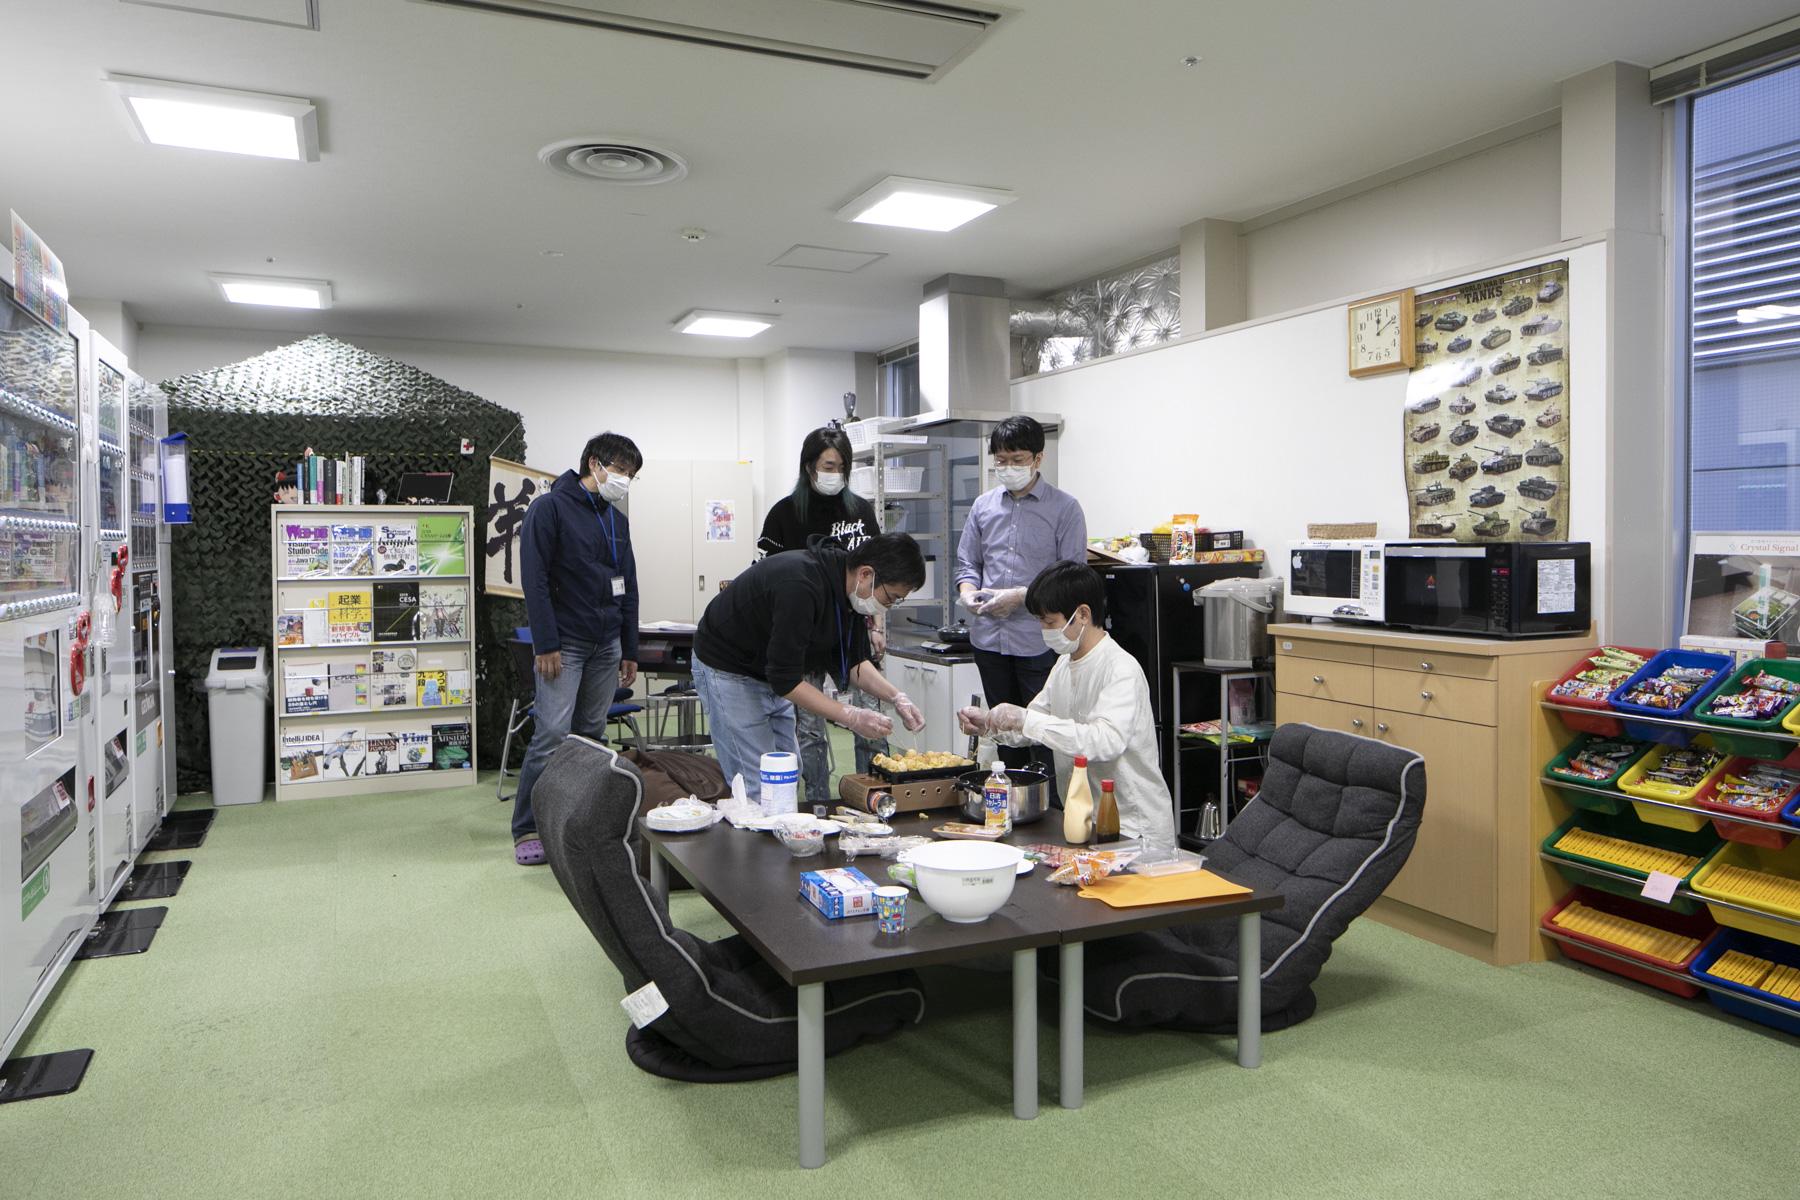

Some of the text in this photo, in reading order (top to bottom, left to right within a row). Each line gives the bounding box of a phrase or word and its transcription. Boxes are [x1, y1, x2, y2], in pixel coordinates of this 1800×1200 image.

[1459, 283, 1481, 295] WORLD
[1482, 279, 1498, 289] WAR
[1464, 286, 1503, 304] TANKS
[1360, 343, 1366, 353] 8
[1384, 347, 1391, 358] 5
[1368, 351, 1374, 361] 7
[1375, 351, 1382, 361] 6
[830, 519, 865, 538] Black
[288, 546, 310, 555] Studio
[311, 547, 329, 555] Code
[1740, 543, 1799, 554] Crystal Signal
[338, 594, 361, 606] 起業
[282, 734, 320, 743] IntelliJ IDEA
[402, 732, 428, 743] Vim
[437, 730, 470, 743] Ansible
